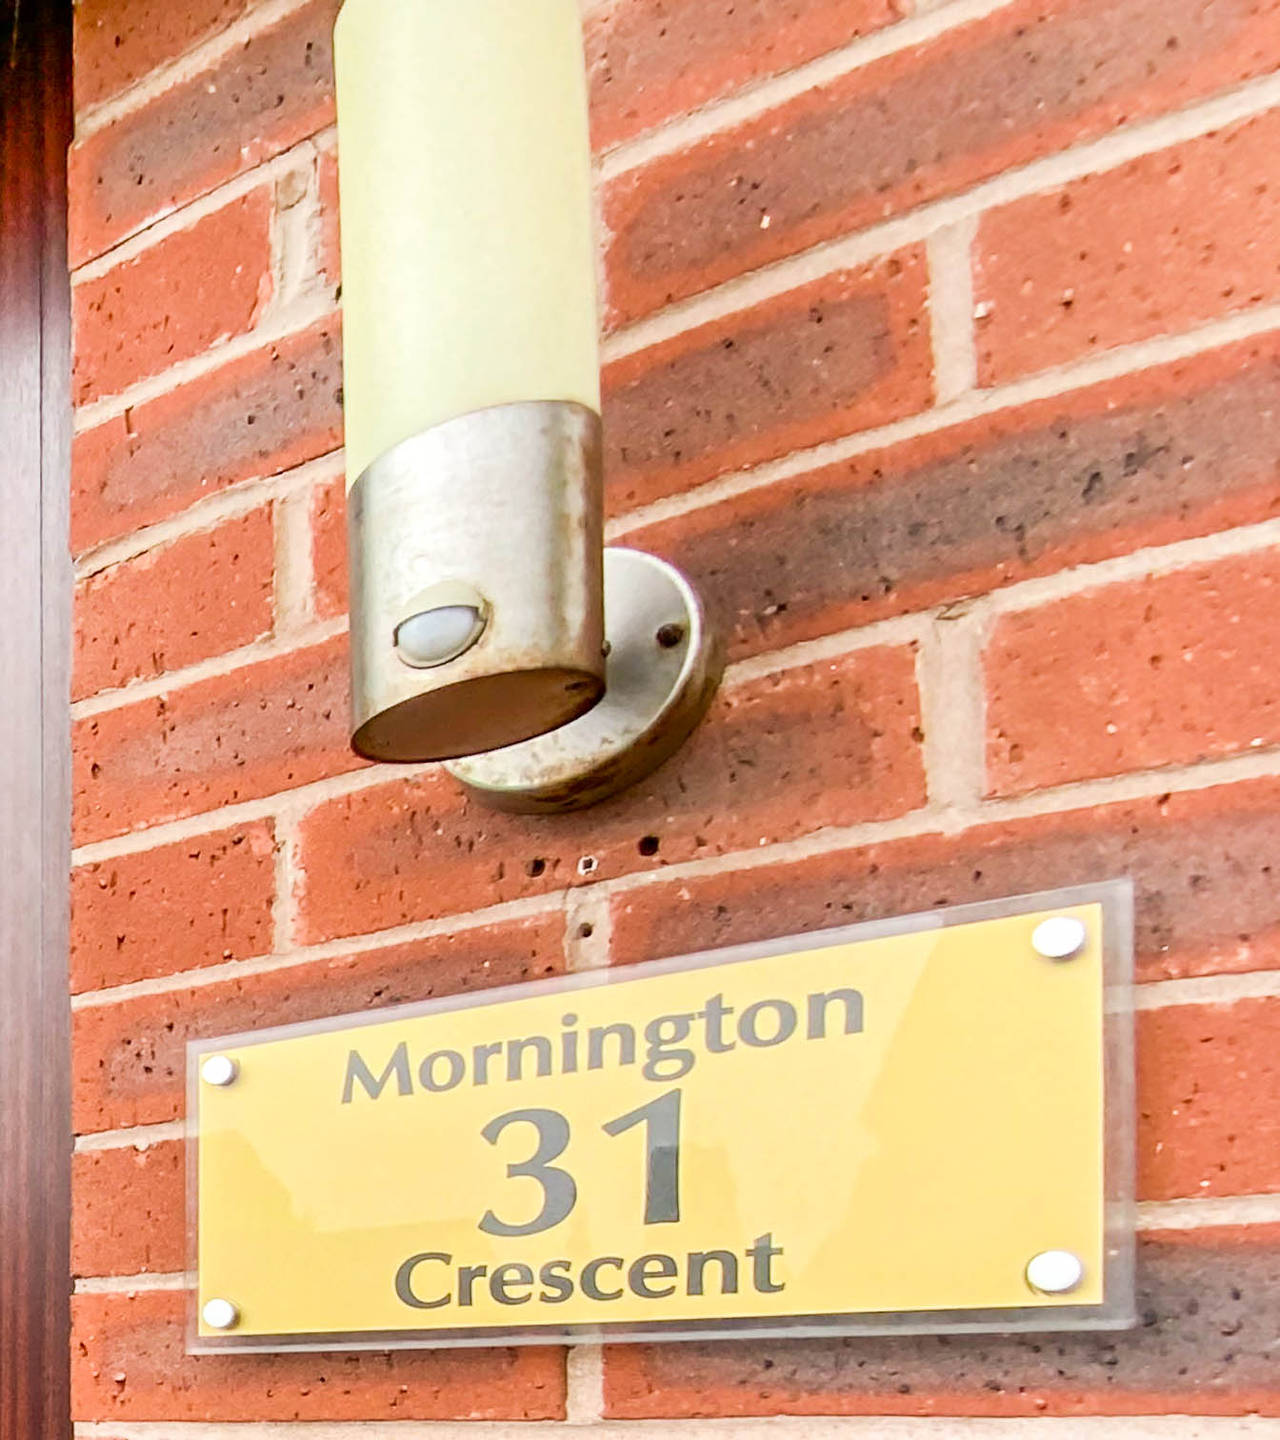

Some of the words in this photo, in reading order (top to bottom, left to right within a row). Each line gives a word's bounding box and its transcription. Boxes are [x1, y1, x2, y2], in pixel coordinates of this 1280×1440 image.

[340, 986, 864, 1104] Mornington
[478, 1088, 682, 1238] 31
[395, 1232, 786, 1309] Crescent
